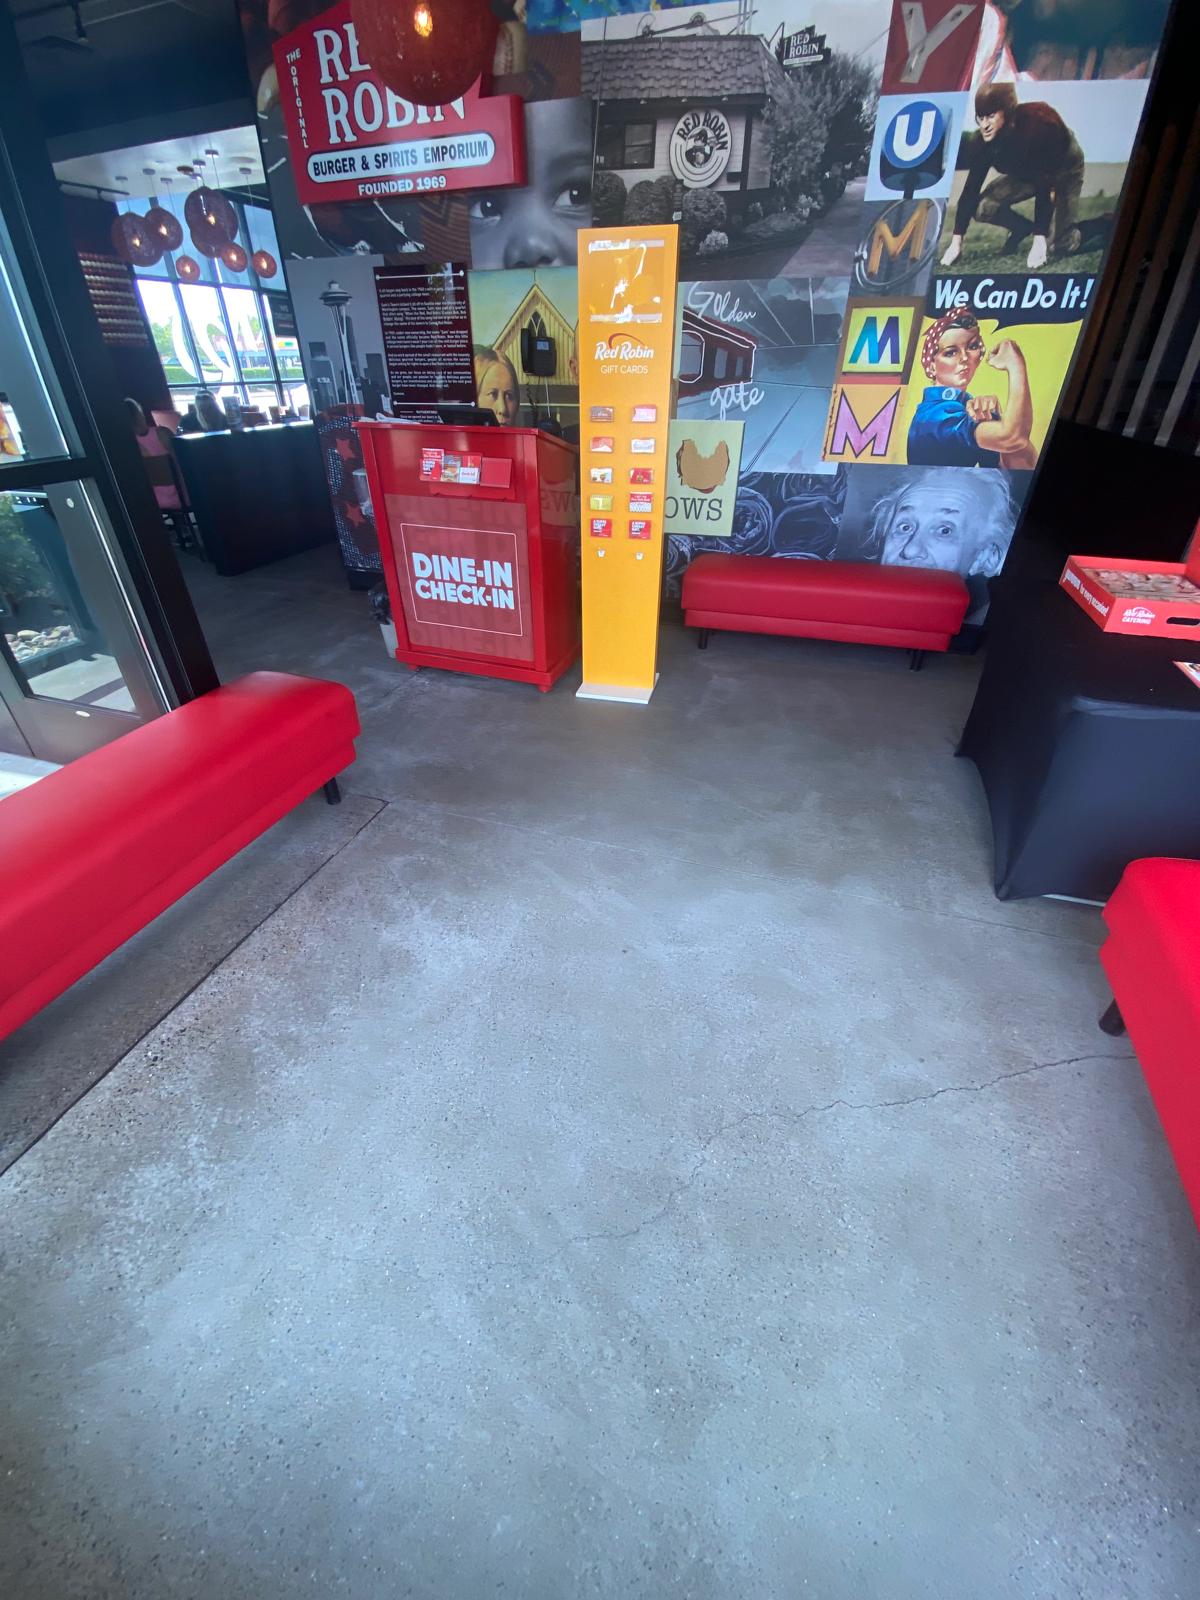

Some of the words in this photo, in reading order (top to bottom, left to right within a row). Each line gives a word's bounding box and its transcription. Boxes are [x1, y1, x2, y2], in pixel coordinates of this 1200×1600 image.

[286, 48, 302, 64] THE
[313, 22, 371, 84] RE
[789, 43, 819, 58] ROBIN
[790, 33, 810, 47] RED
[290, 66, 309, 149] ORIGINAL
[677, 112, 701, 141] RED
[702, 111, 729, 151] ROBIN
[892, 109, 937, 161] U
[312, 157, 356, 177] BURGER
[361, 154, 370, 171] &
[374, 148, 418, 169] SPIRITS
[424, 140, 489, 164] EMPORIUM
[358, 178, 414, 196] FOUNDED
[416, 175, 447, 191] 1969
[935, 279, 969, 309] We
[973, 278, 1018, 309] Can
[1021, 278, 1057, 309] Do
[1060, 278, 1095, 309] It!
[594, 341, 618, 360] Red
[619, 340, 655, 360] Robin
[849, 315, 902, 365] M
[600, 364, 618, 374] GIFT
[620, 364, 649, 374] CARDS
[709, 381, 765, 420] gate
[830, 388, 900, 456] M
[412, 552, 513, 588] DINE-IN
[415, 580, 515, 610] CHECK-IN
